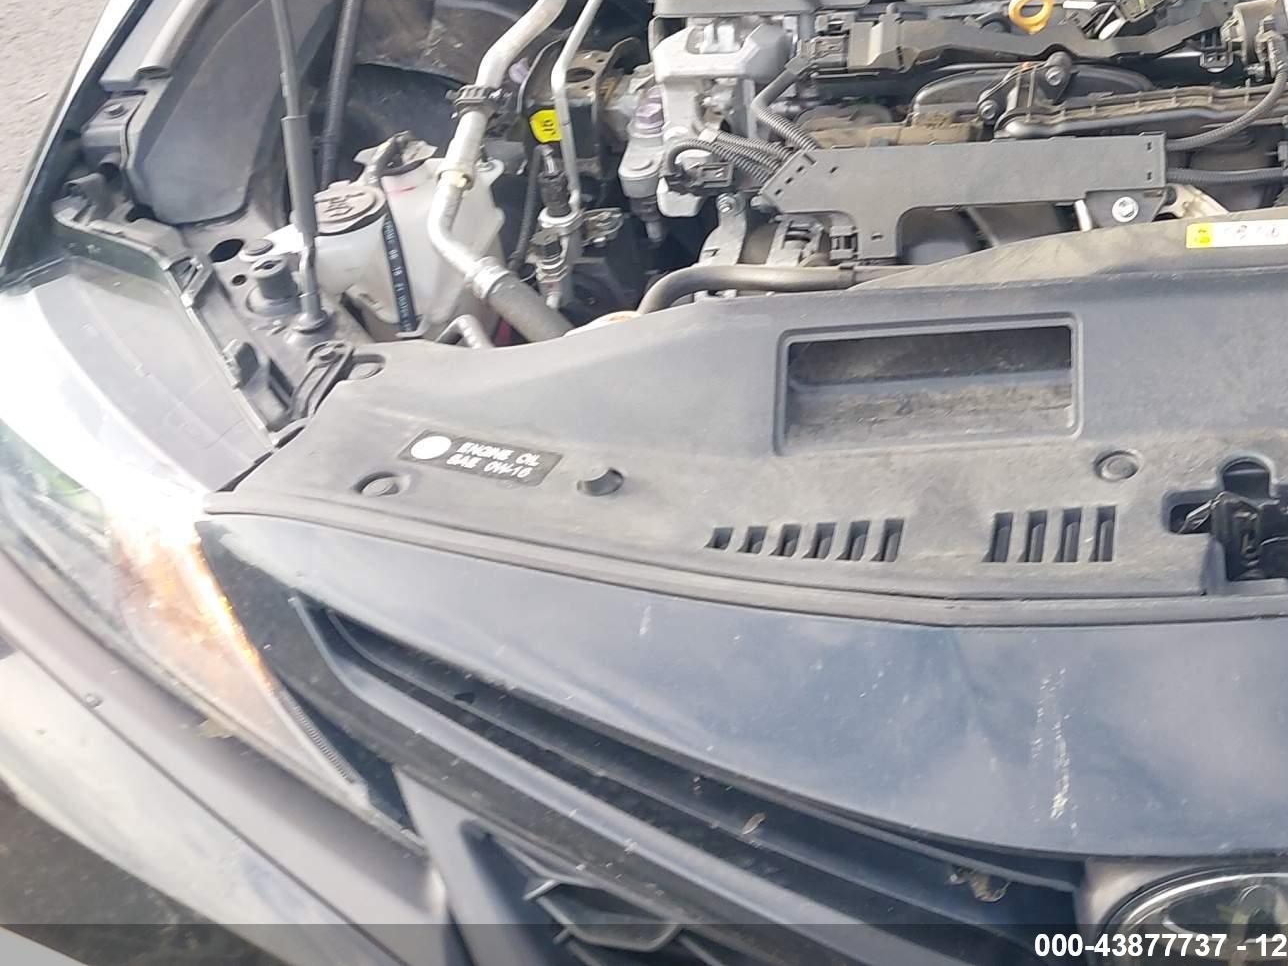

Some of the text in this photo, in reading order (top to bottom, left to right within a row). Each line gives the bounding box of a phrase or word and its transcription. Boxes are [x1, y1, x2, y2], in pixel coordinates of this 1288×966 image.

[446, 453, 482, 469] SAE
[456, 442, 540, 467] ENGINE OIL
